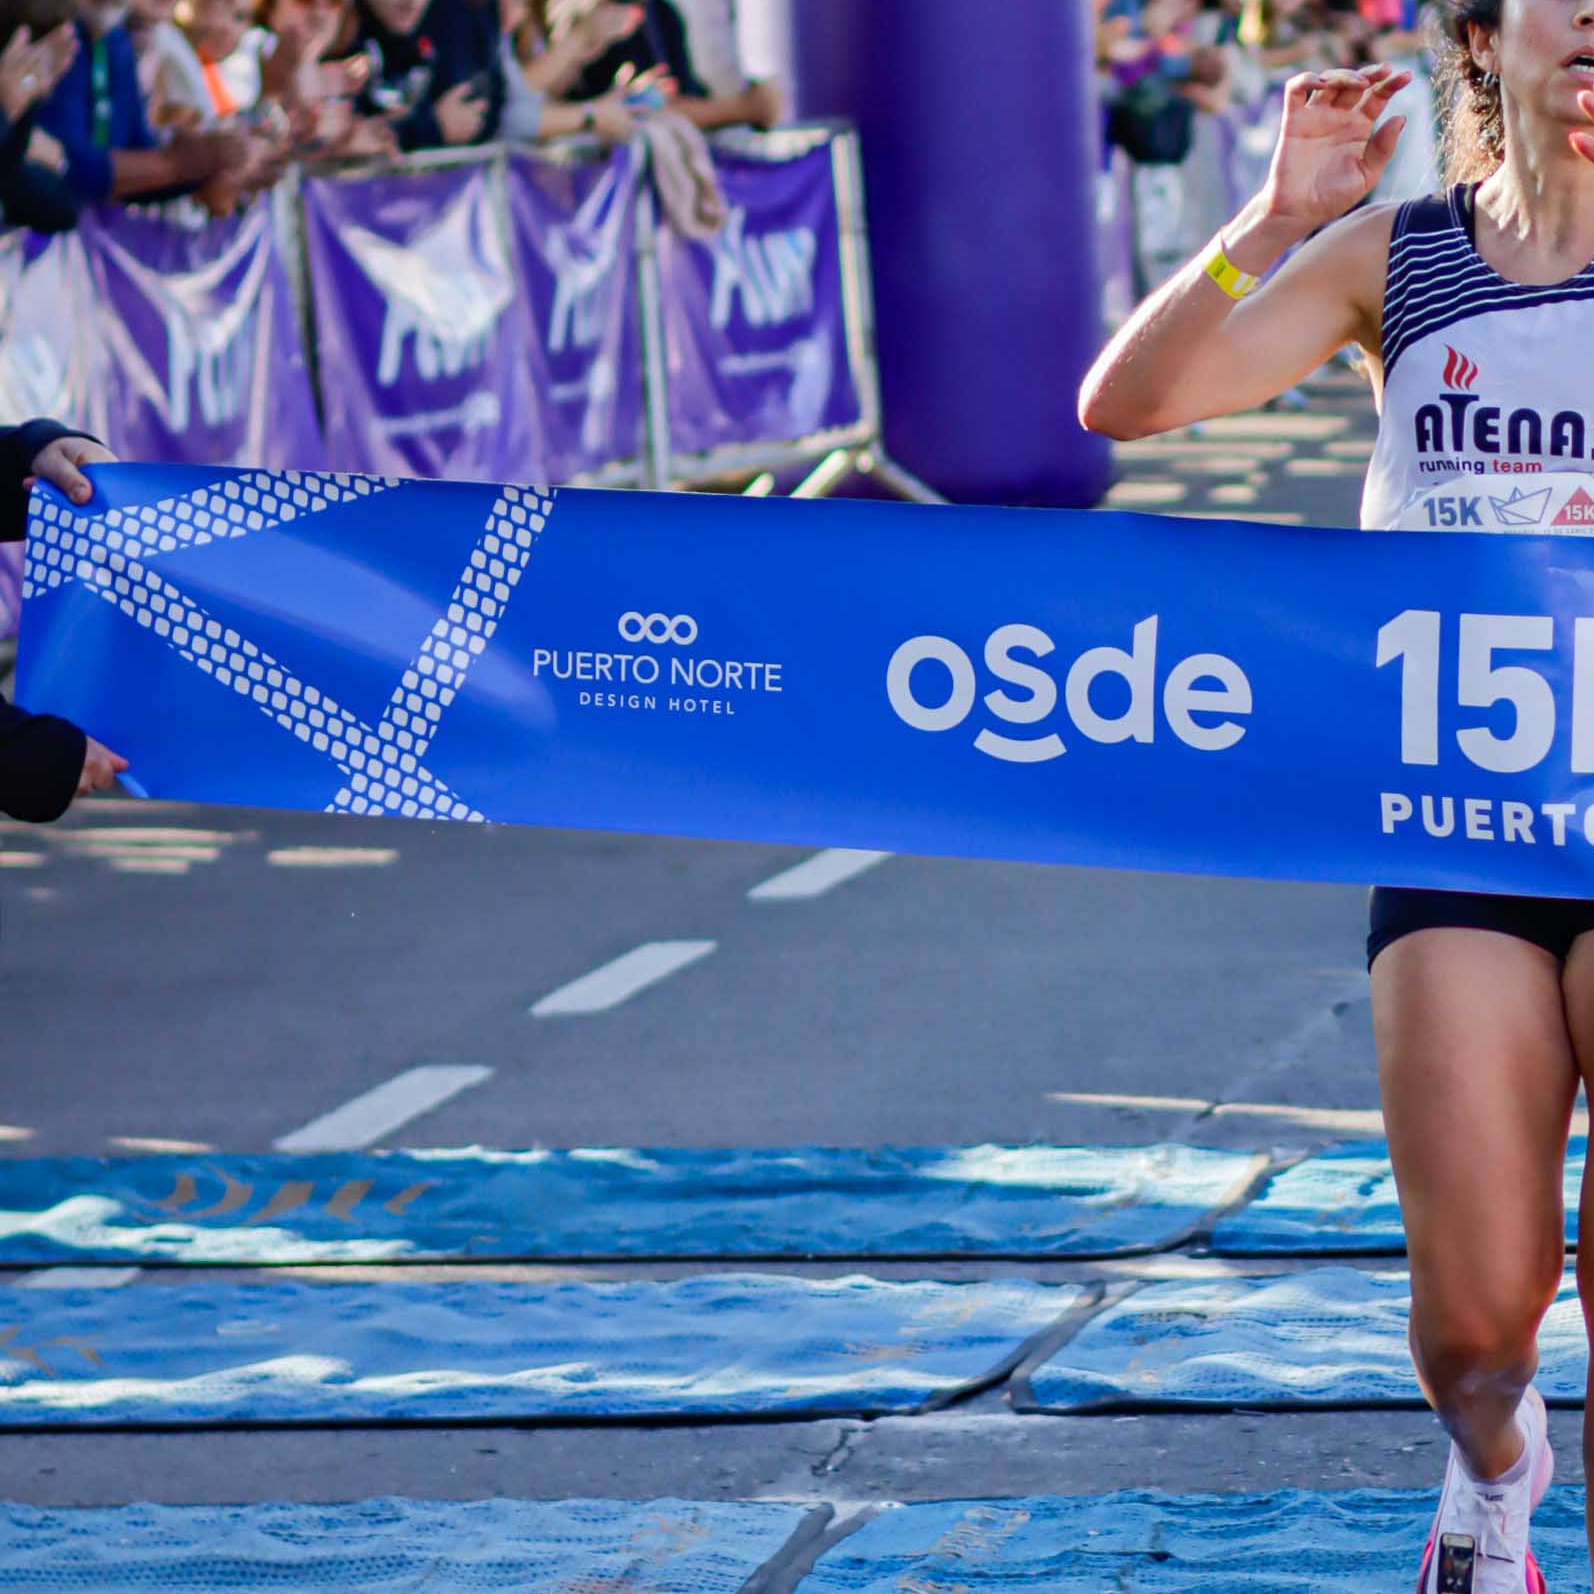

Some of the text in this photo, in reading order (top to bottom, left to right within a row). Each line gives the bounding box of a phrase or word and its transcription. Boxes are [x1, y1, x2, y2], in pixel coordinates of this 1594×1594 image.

[1419, 458, 1542, 475] running team
[1423, 496, 1483, 526] 15K
[533, 649, 783, 692] PUERTO NORTE
[887, 614, 1253, 752] osde
[579, 692, 735, 715] DESIGN HOTEL
